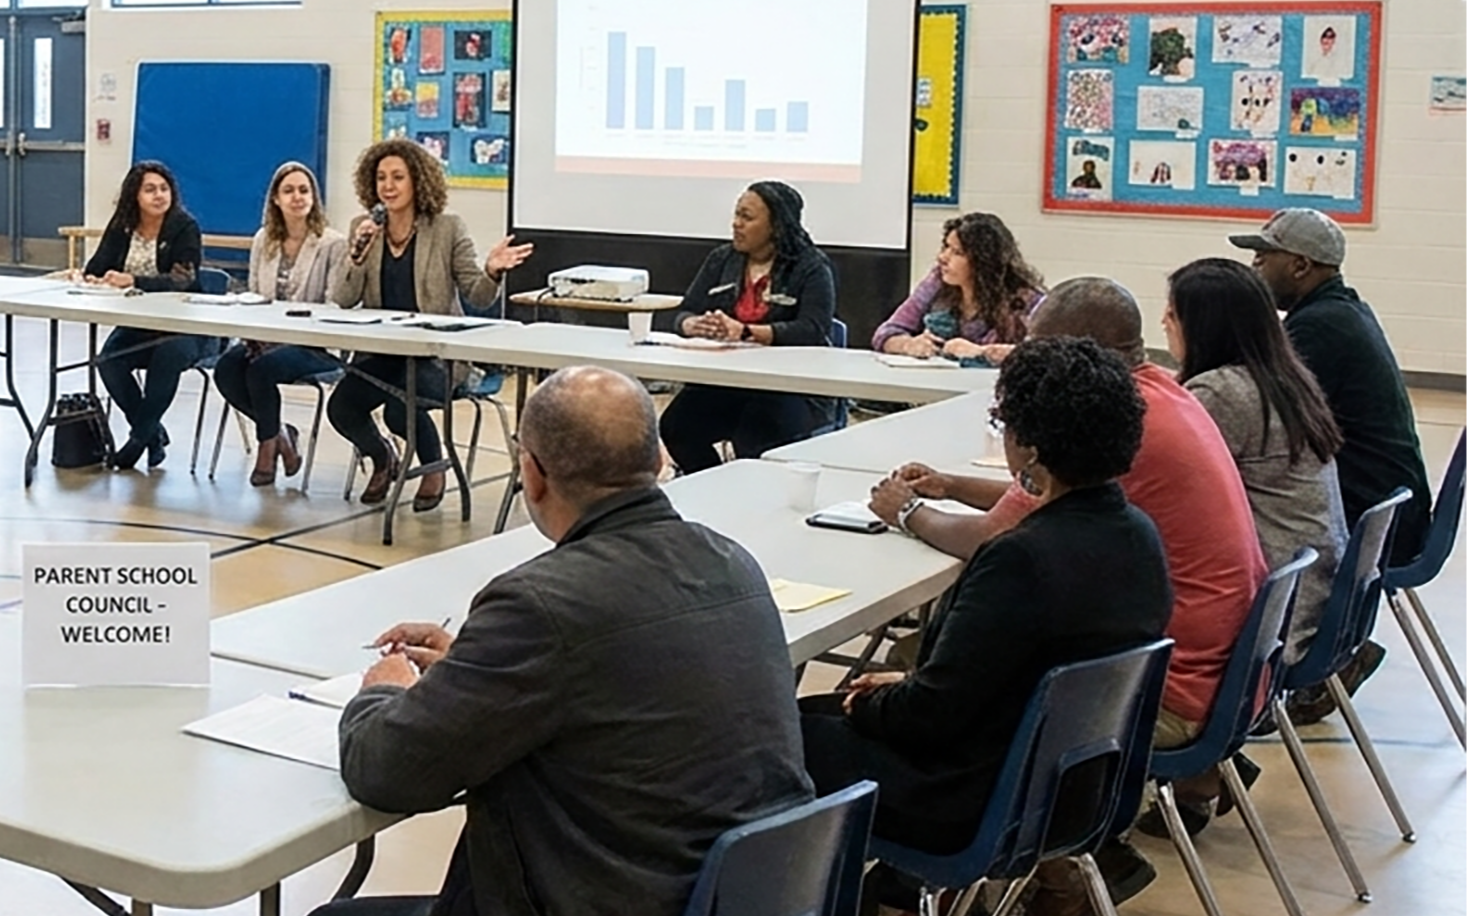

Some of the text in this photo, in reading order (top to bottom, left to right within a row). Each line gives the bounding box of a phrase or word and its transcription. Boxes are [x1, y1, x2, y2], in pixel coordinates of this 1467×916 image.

[34, 566, 198, 585] PARENT SCHOOL
[66, 596, 153, 614] COUNCIL
[60, 625, 171, 643] WELCOME!
